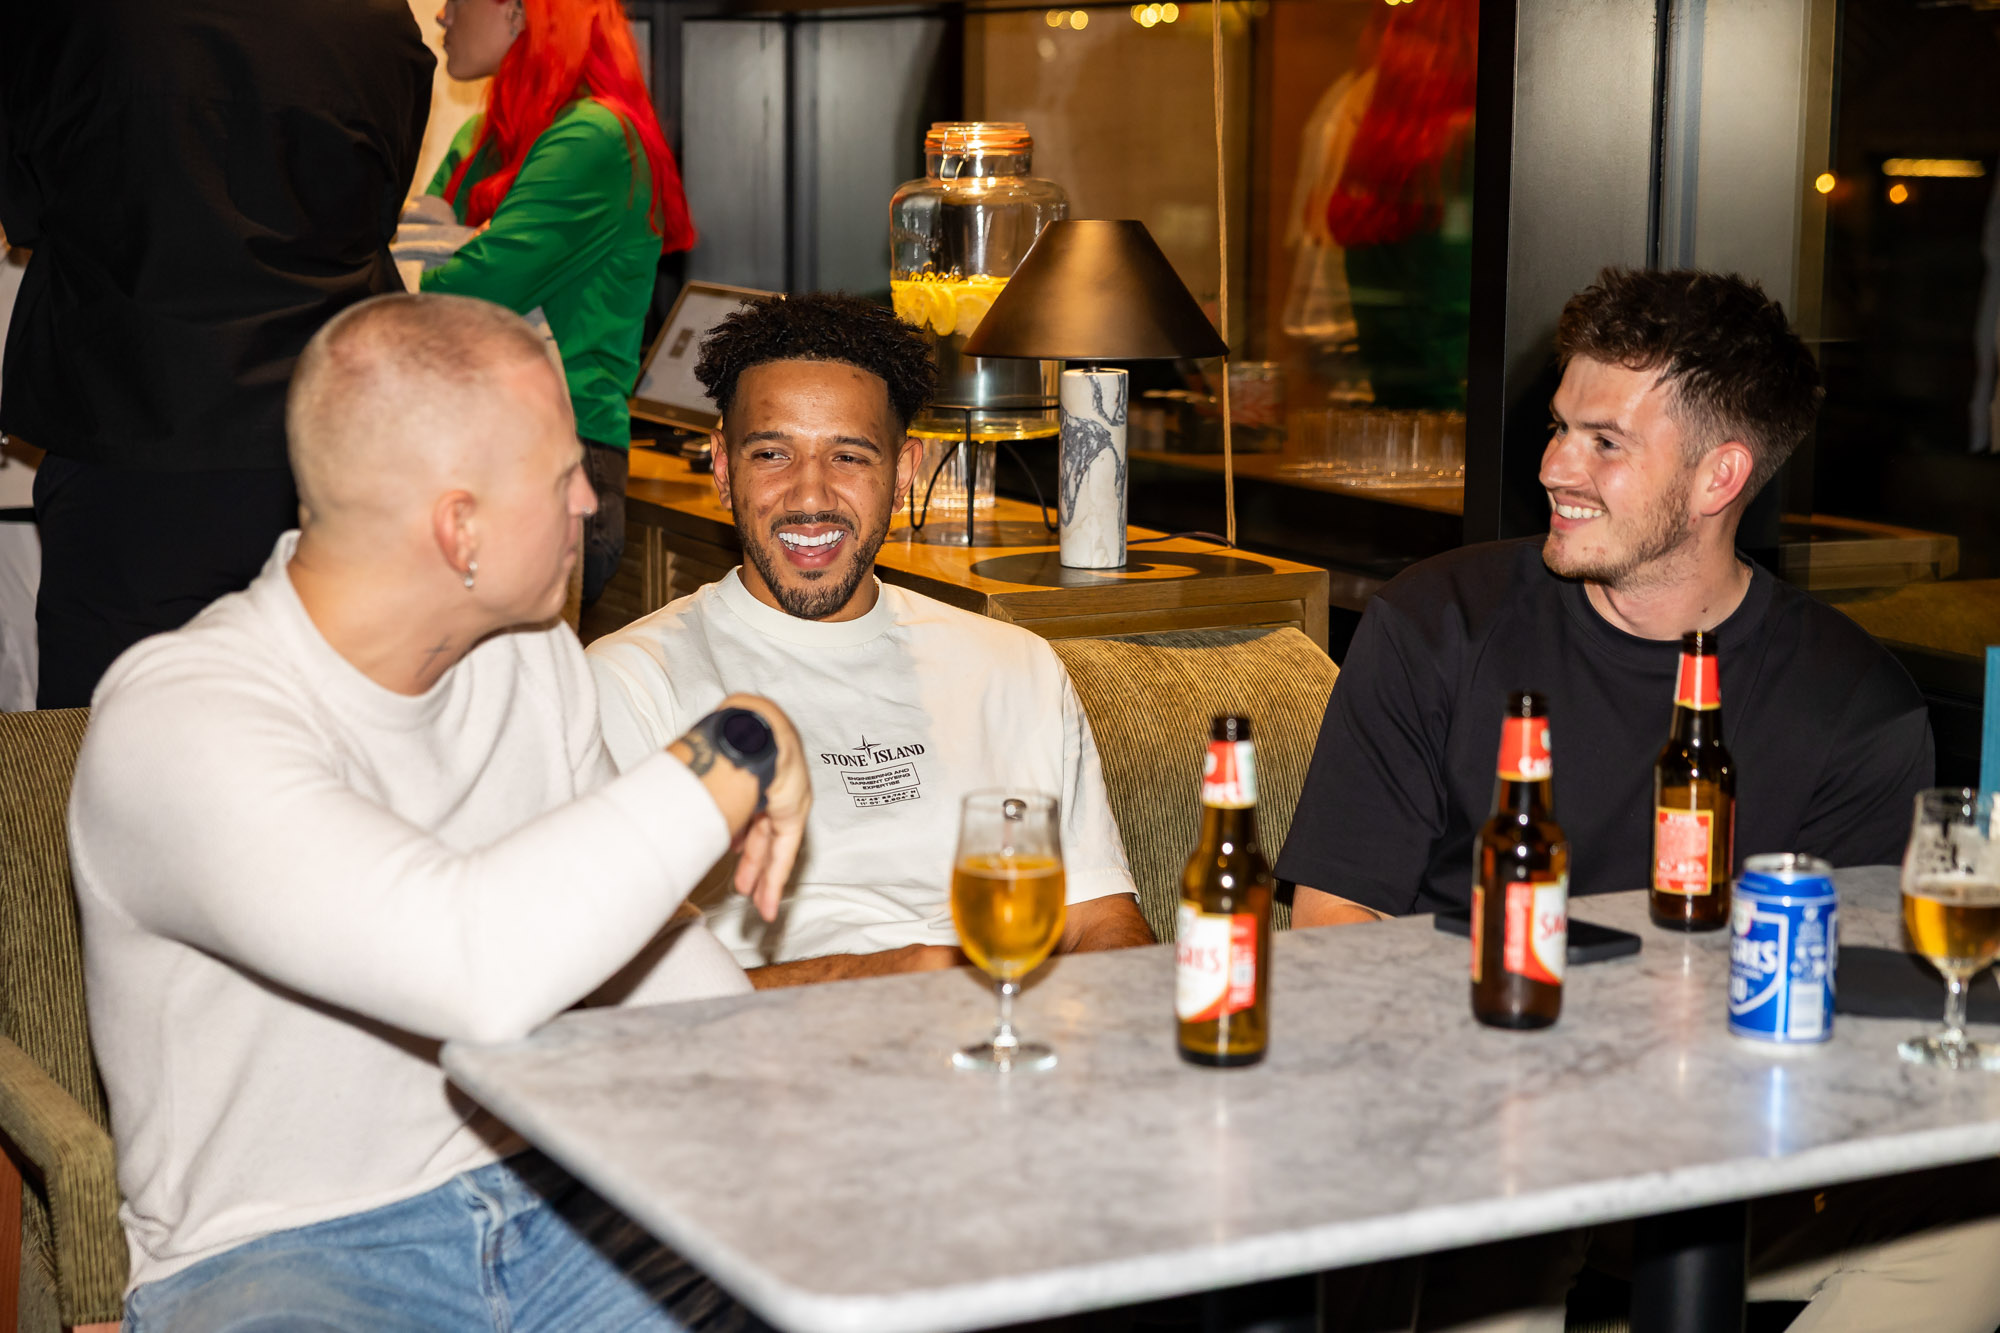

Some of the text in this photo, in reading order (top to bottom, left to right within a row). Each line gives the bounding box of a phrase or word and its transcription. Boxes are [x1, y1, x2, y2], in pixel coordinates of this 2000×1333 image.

[820, 743, 925, 767] STONE ISLAND
[847, 772, 893, 781] ENGINEERING
[884, 773, 911, 782] DYEING
[862, 780, 900, 790] EXPERTISE
